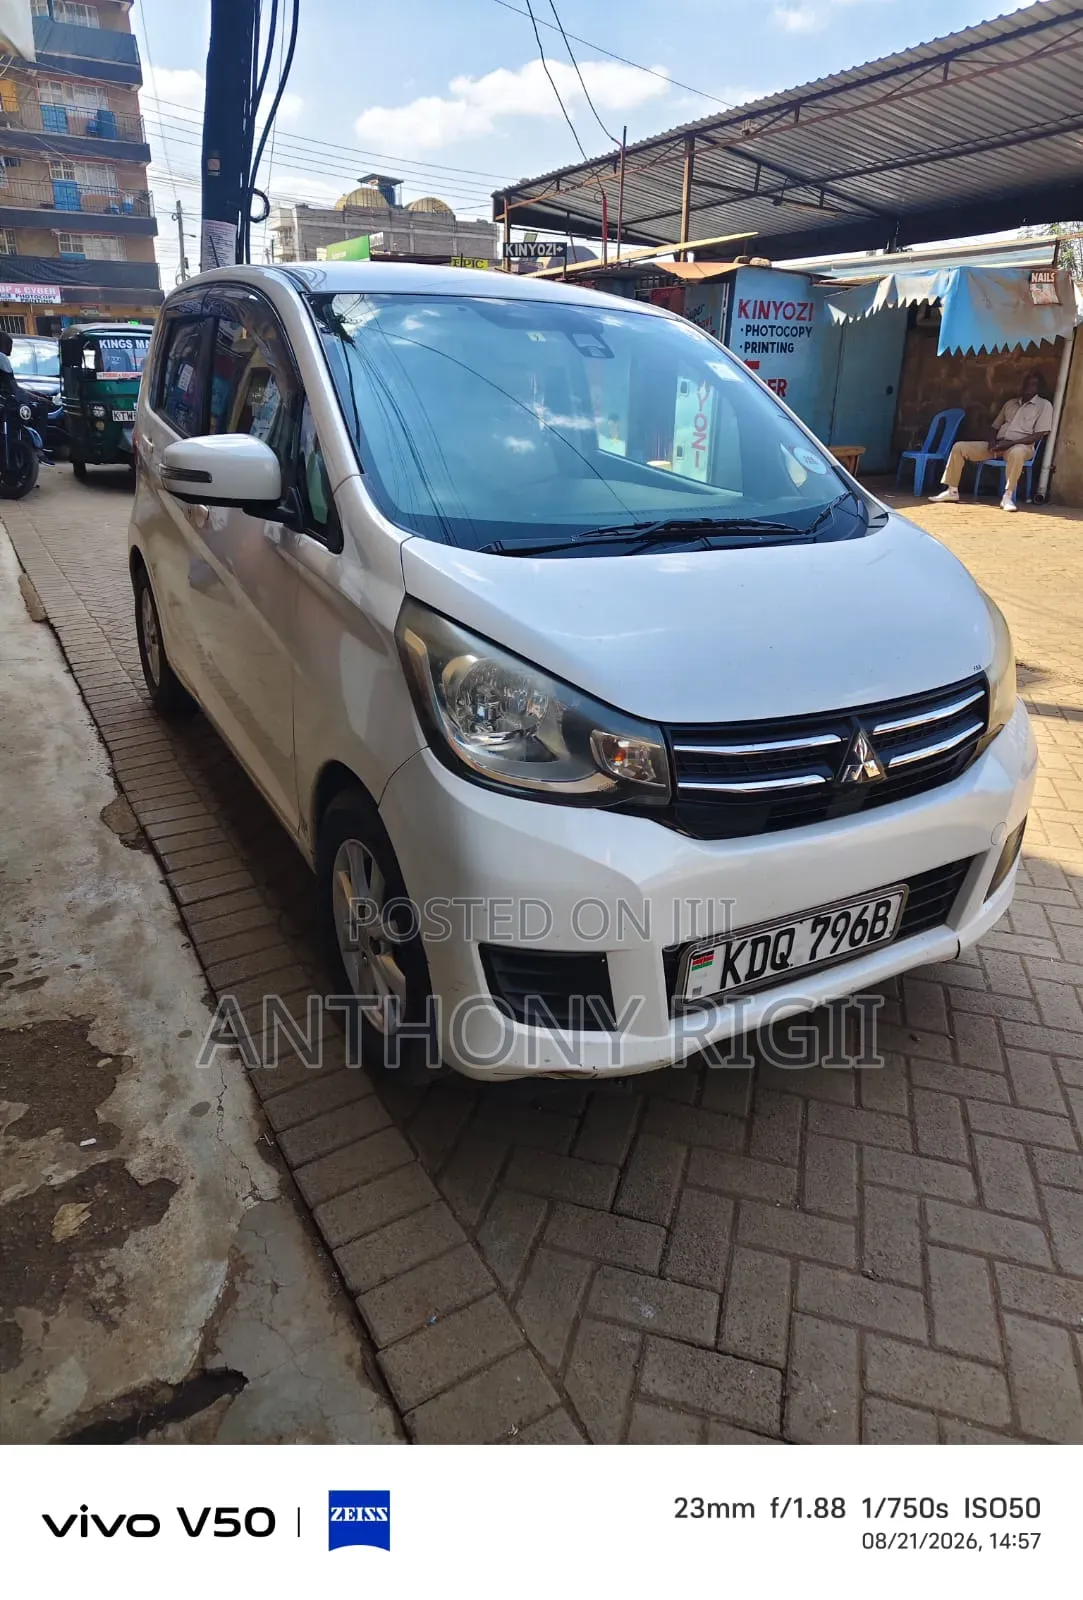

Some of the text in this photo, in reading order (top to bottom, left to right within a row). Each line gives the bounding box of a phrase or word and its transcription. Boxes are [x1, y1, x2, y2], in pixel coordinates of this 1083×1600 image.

[505, 243, 557, 257] KINYOZI
[454, 260, 485, 269] EPIC
[1031, 272, 1055, 283] NAILS
[738, 298, 814, 322] KINYOZI
[745, 324, 813, 338] PHOTOCOPY
[99, 339, 133, 349] KINGS
[744, 341, 794, 353] PRINTING
[763, 378, 788, 397] ER
[719, 898, 893, 990] KDQ 796B
